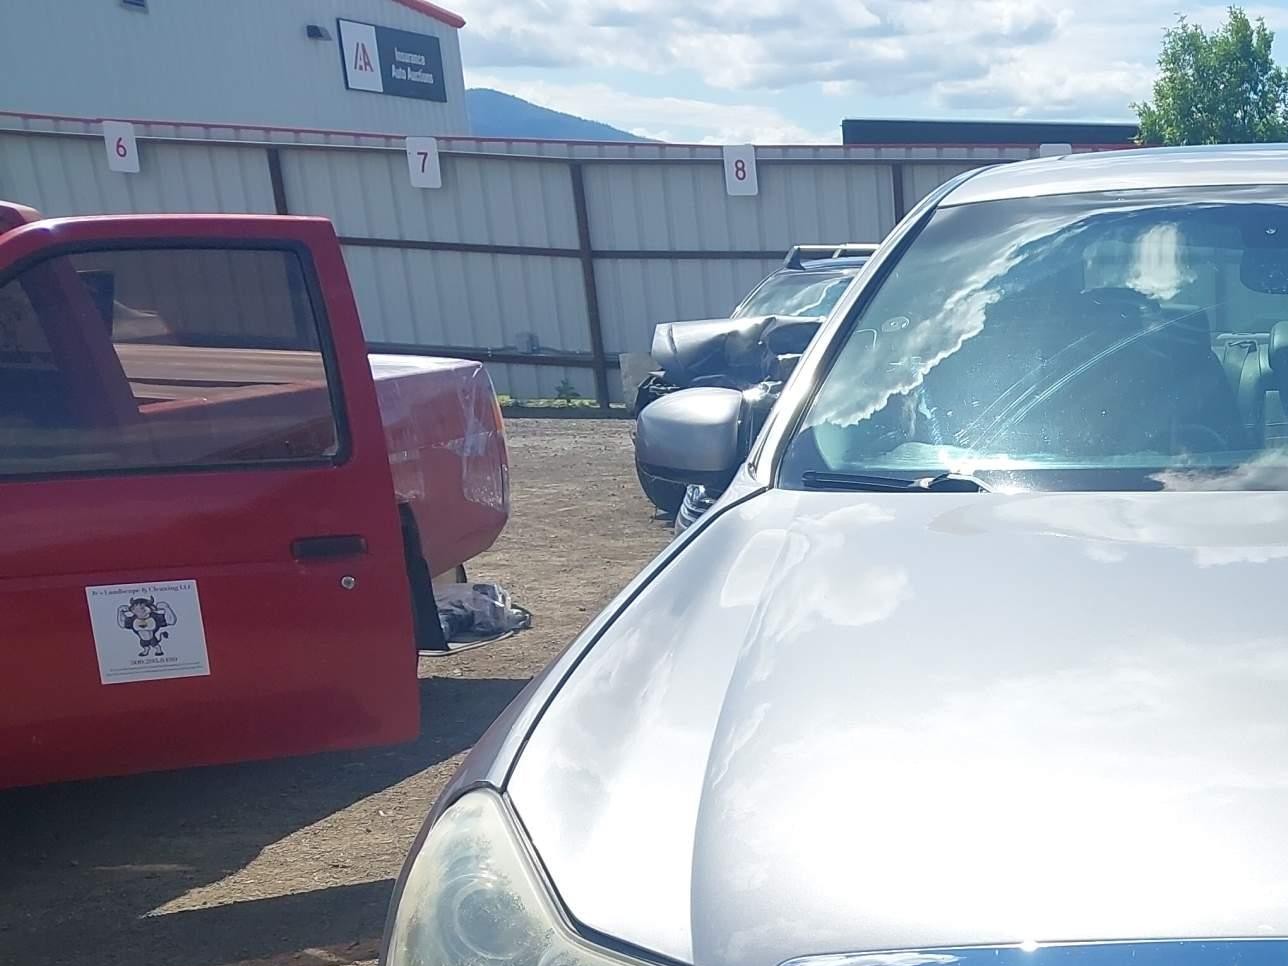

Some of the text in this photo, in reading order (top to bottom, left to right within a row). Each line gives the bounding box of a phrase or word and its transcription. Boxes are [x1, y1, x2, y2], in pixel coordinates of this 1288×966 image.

[394, 47, 426, 66] Insurance
[391, 63, 434, 84] Auto Auctions
[116, 136, 127, 157] 6
[416, 151, 428, 174] 7
[735, 159, 746, 181] 8
